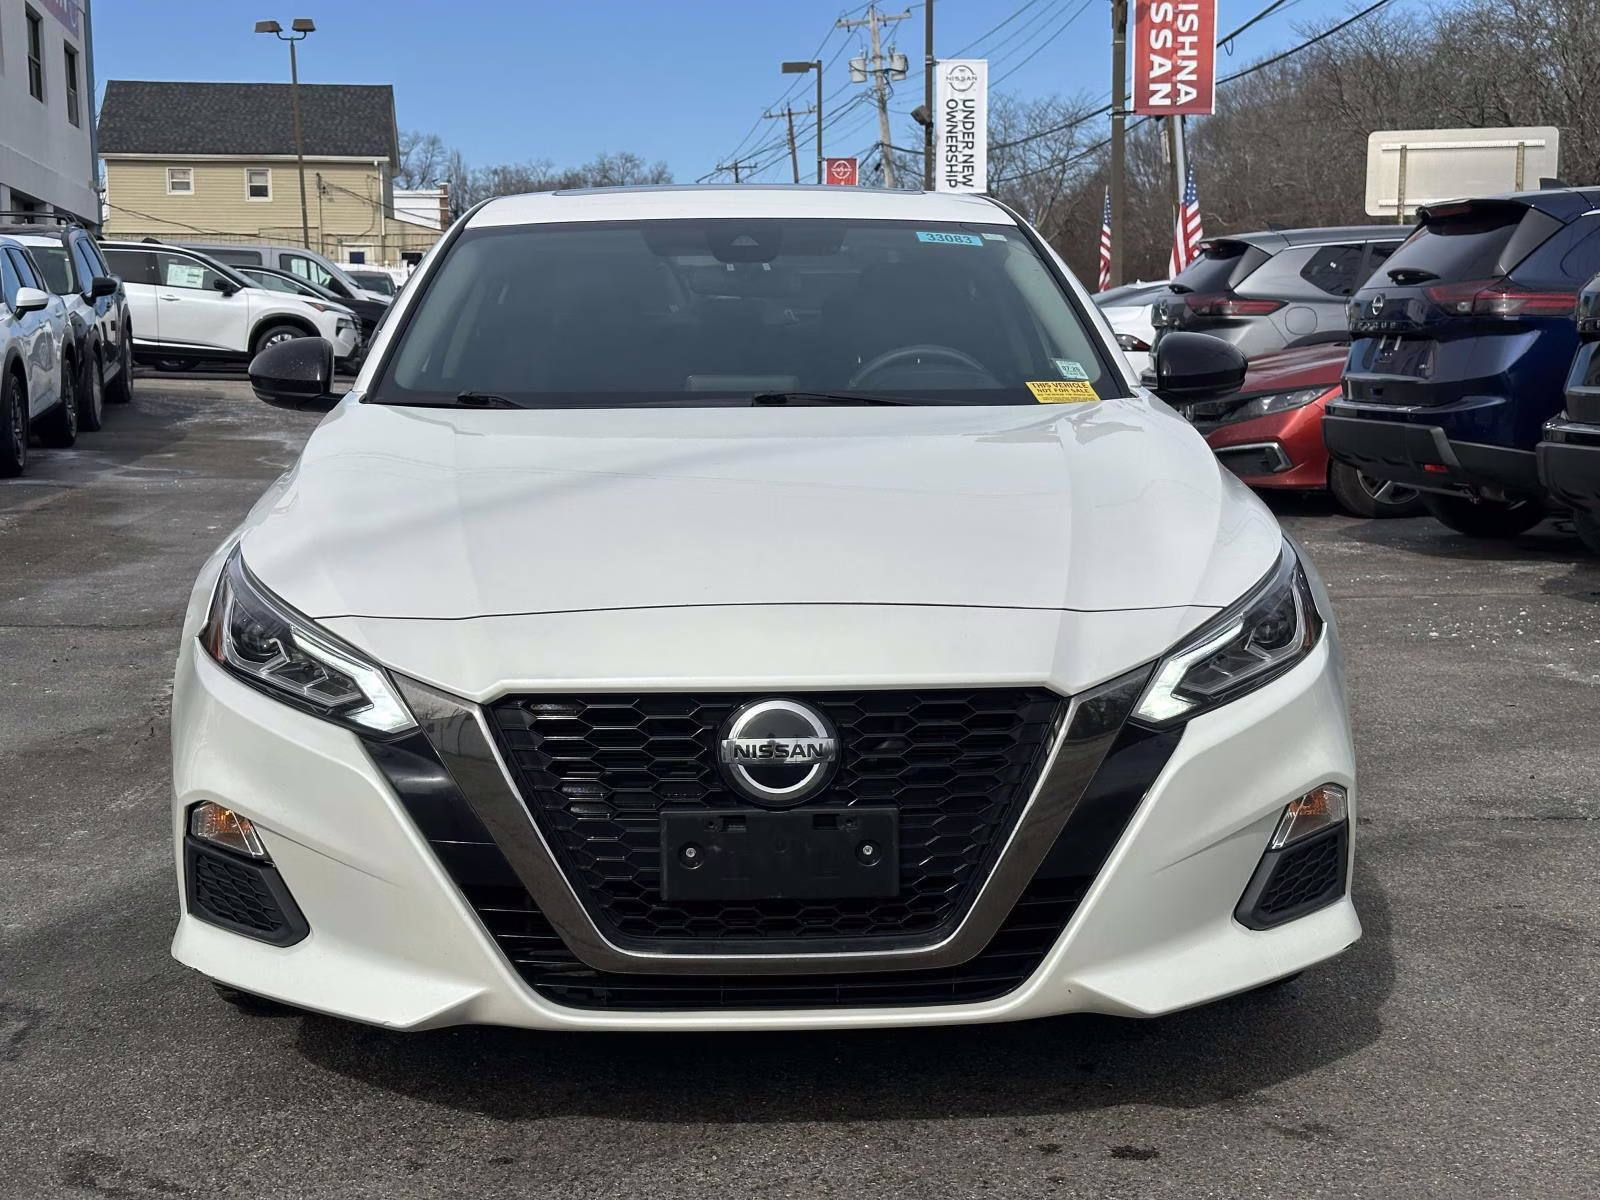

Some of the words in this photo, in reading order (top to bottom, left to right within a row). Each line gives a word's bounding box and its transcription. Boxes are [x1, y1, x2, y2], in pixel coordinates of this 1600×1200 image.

[962, 98, 976, 150] UNDER
[945, 98, 959, 188] OWNERSHIP
[962, 154, 975, 188] NEW
[926, 233, 973, 244] 33083
[733, 743, 824, 759] NISSAN
